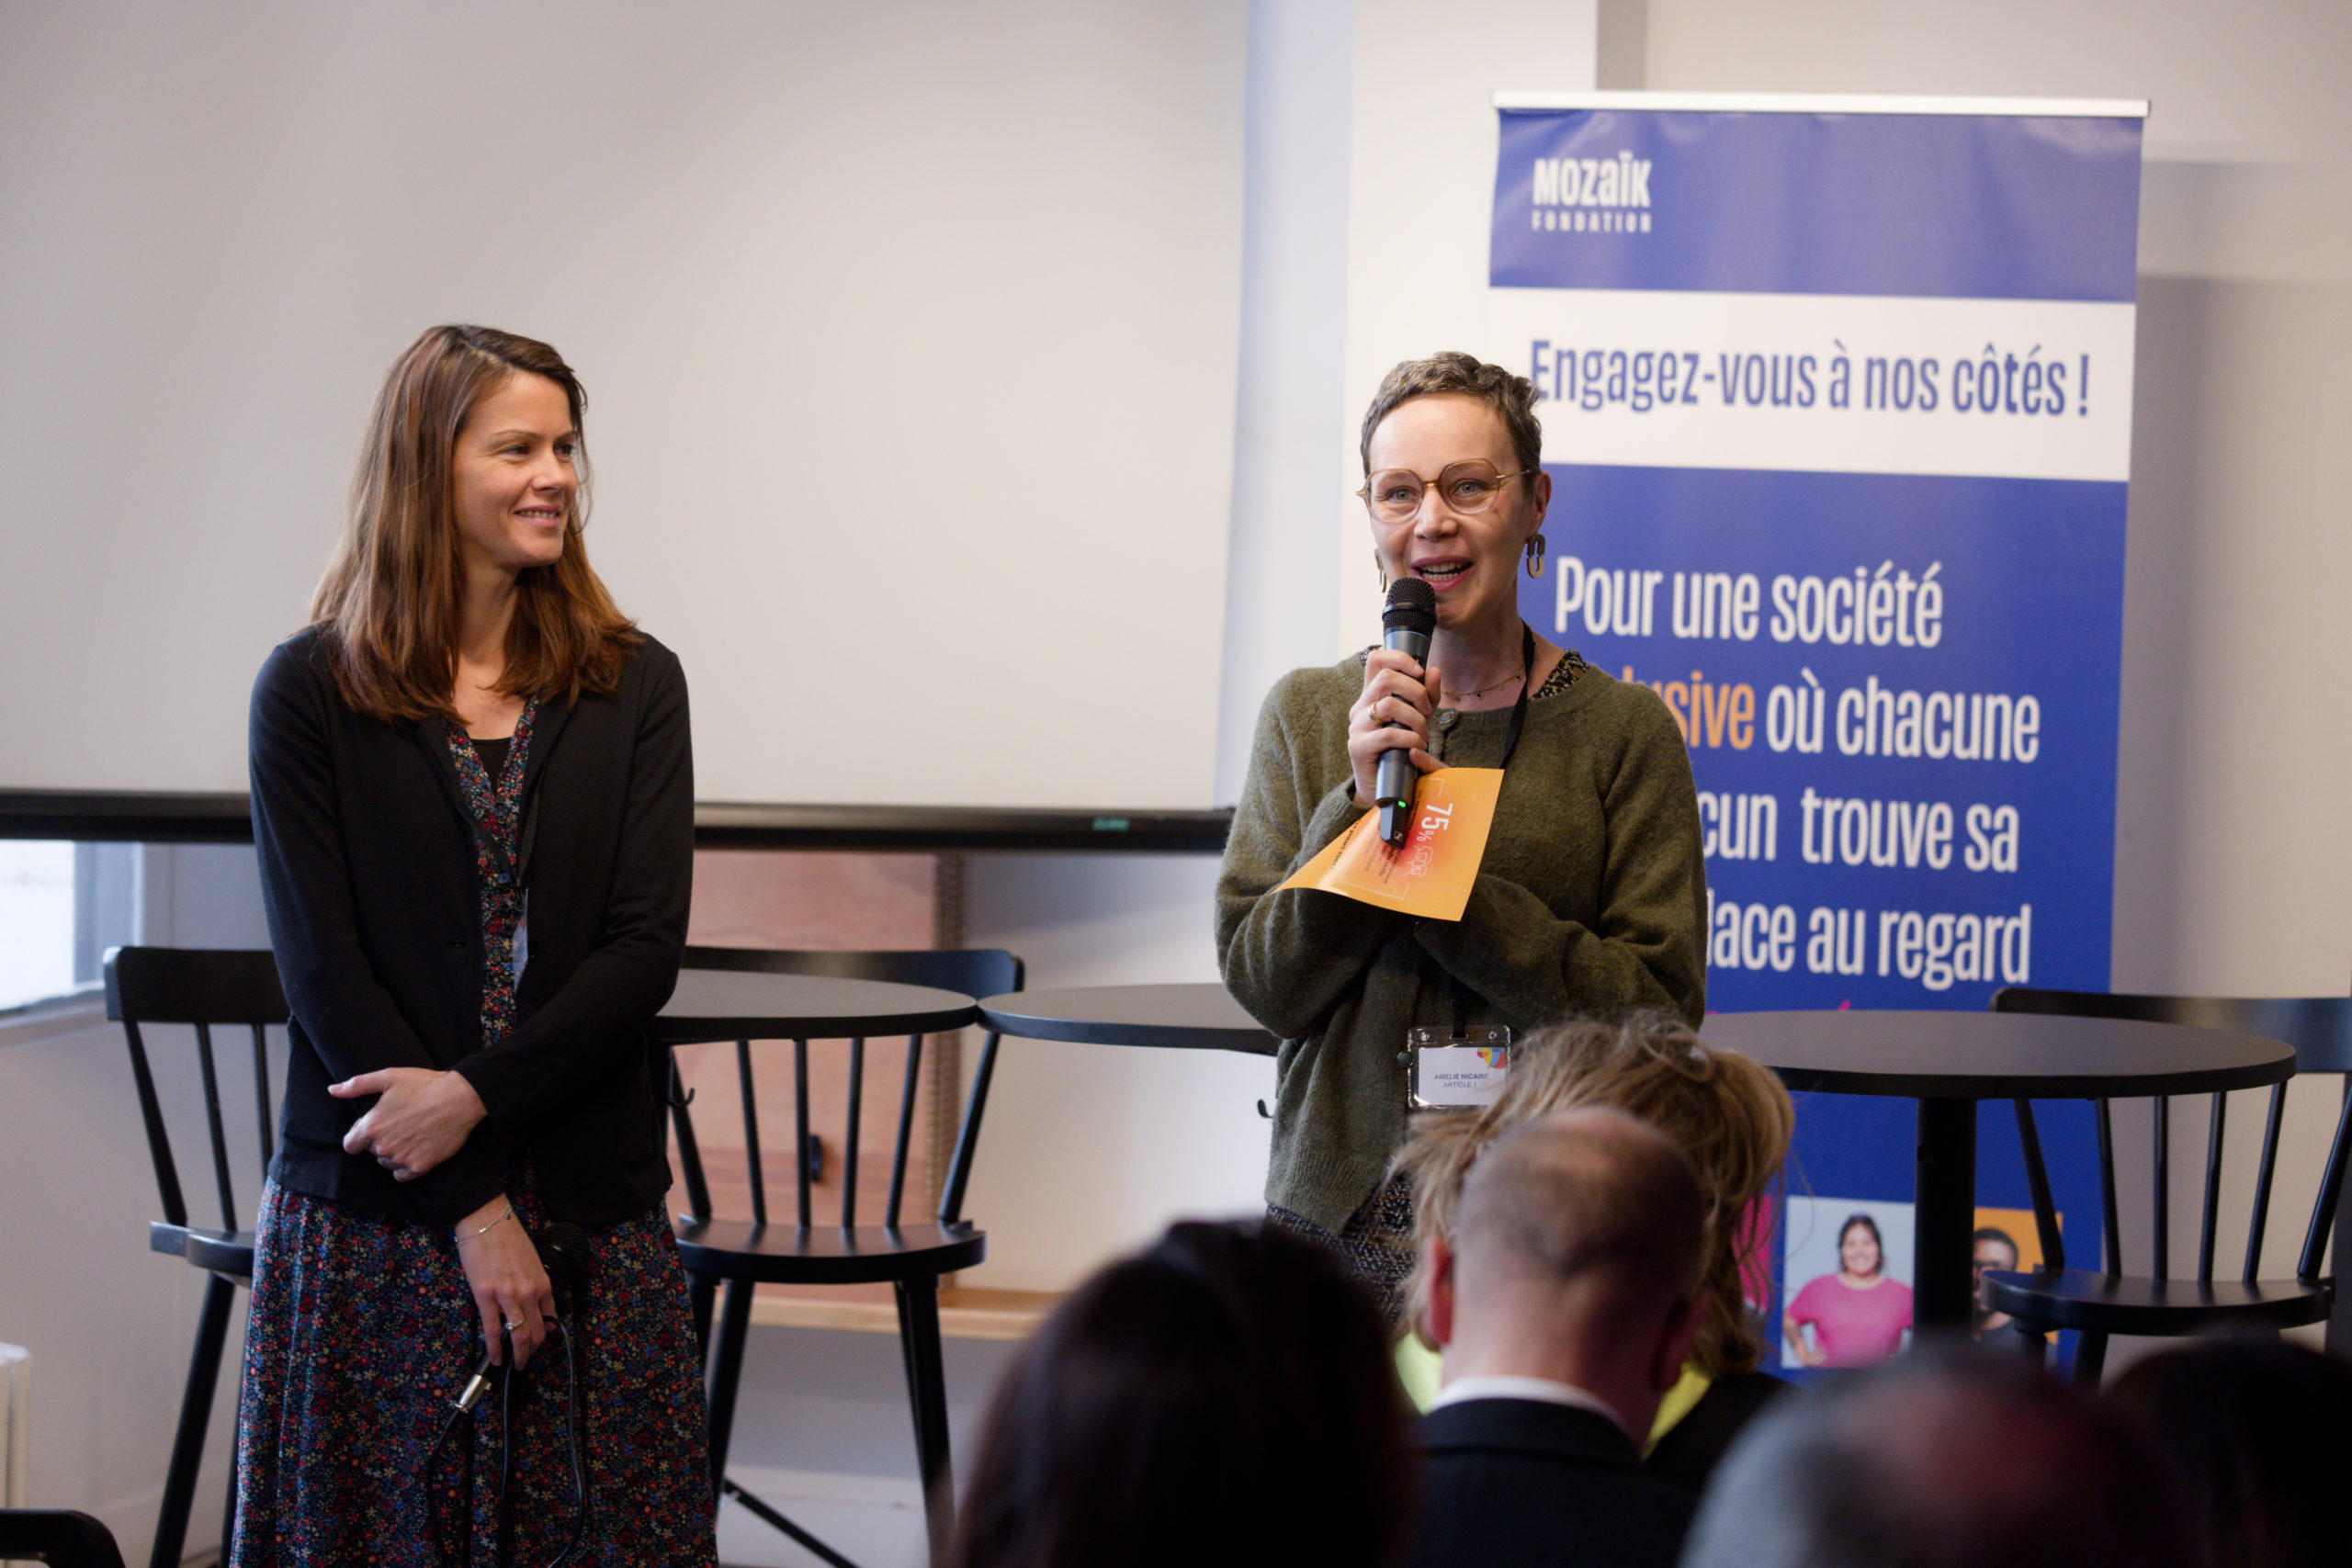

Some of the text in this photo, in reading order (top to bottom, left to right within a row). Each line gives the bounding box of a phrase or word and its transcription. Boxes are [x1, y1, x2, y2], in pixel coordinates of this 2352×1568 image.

[1531, 210, 1651, 233] FONDATION
[1531, 340, 1817, 412] Engagez-vous
[1829, 339, 1851, 409] à
[1864, 355, 1939, 412] nos
[1555, 556, 1943, 648] Pour une société
[1766, 667, 1825, 753] où
[1836, 675, 2040, 763] chacune
[1697, 787, 2018, 873] cun trouve sa
[1706, 887, 2031, 991] lace au regard
